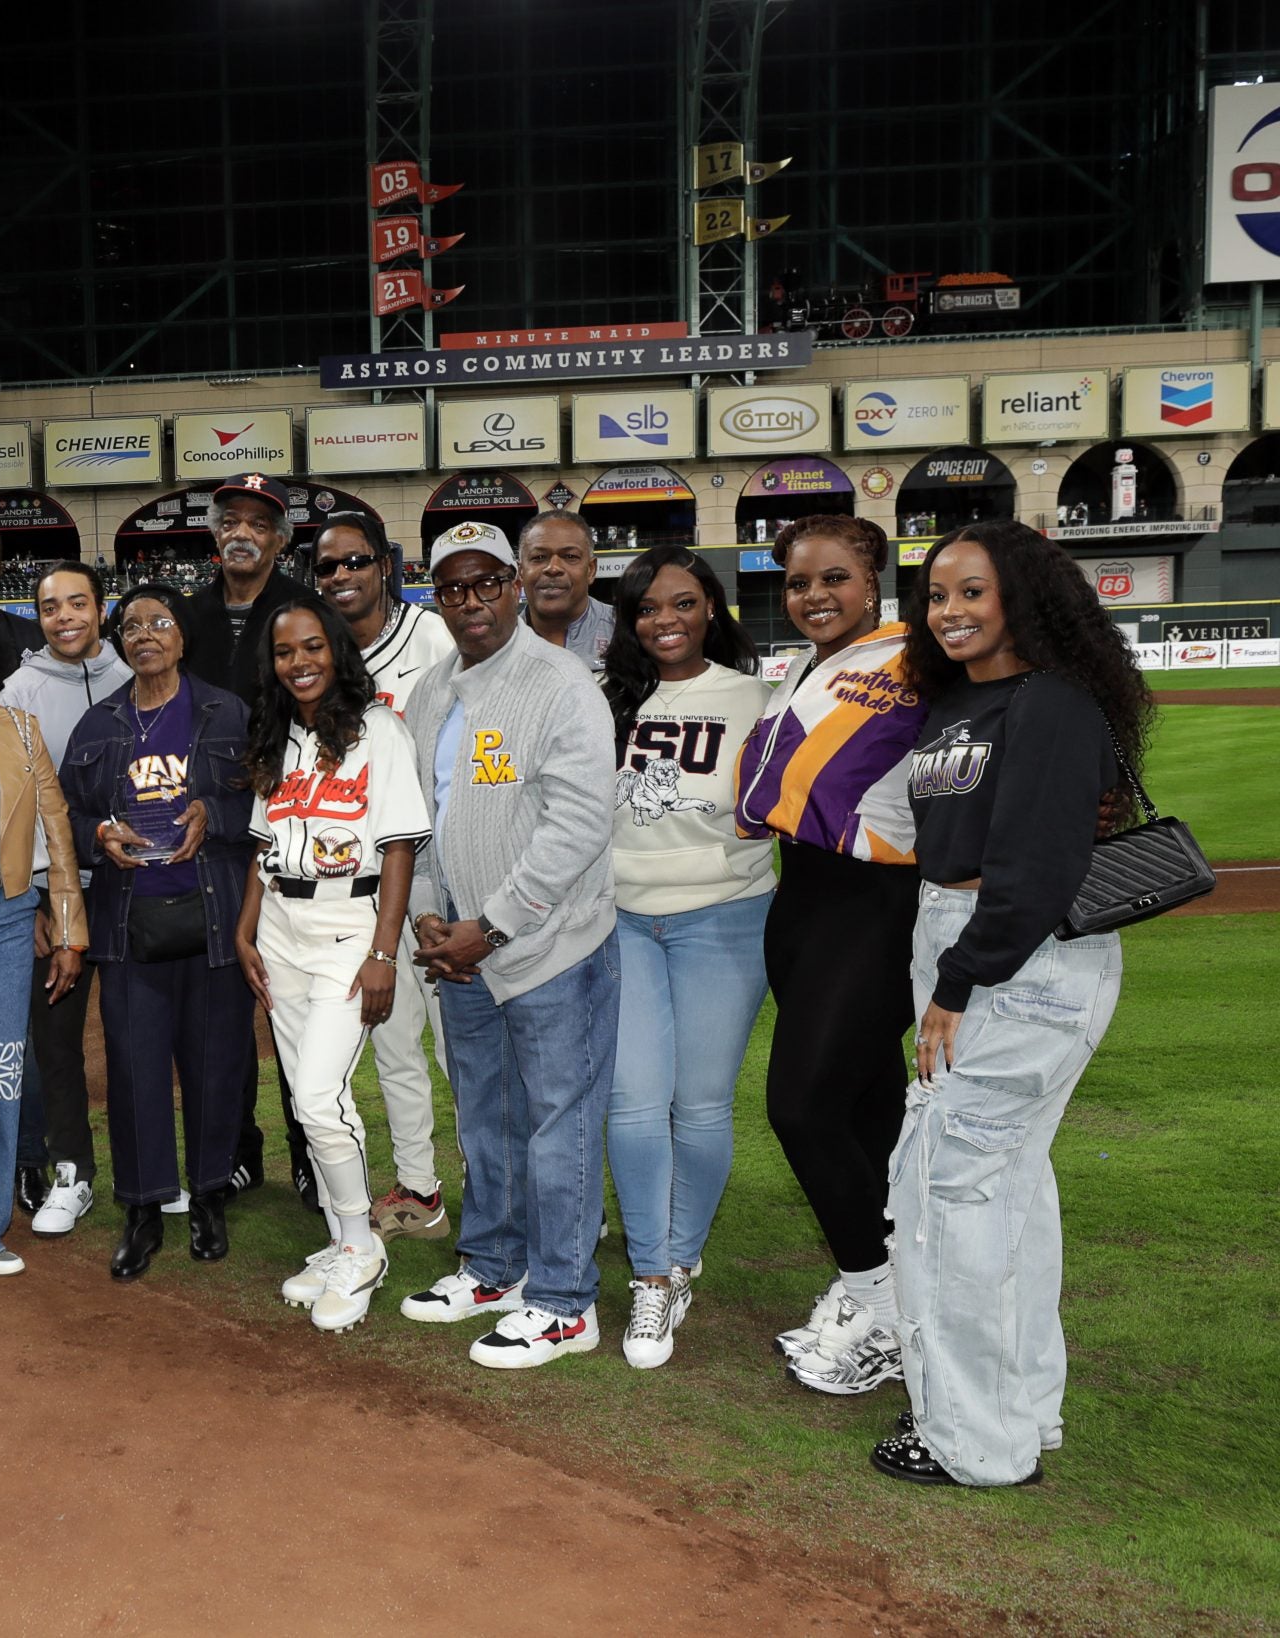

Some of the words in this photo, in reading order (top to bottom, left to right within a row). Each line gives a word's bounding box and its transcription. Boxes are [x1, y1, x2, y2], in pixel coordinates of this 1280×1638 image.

[706, 151, 732, 174] 17
[380, 169, 408, 193] 05
[378, 187, 418, 206] CHAMPIONS
[706, 210, 731, 231] 22
[384, 226, 410, 249] 19
[380, 242, 418, 260] CHAMPIONS
[383, 279, 409, 300] 21
[379, 296, 415, 312] CHAMPIONS
[477, 331, 569, 345] MINUTE
[589, 327, 650, 339] MAID
[340, 358, 447, 380] ASTROS
[462, 348, 646, 373] COMMUNITY
[660, 341, 790, 363] LEADERS
[1161, 371, 1214, 383] Chevron
[1000, 390, 1083, 415] reliant
[627, 403, 669, 430] slb
[732, 408, 803, 432] COTTON
[854, 407, 898, 420] OXY
[907, 406, 938, 419] ZERO
[1000, 424, 1012, 432] an
[1014, 422, 1036, 431] NRG
[1037, 421, 1081, 433] company
[55, 435, 151, 452] CHENIERE
[314, 432, 419, 446] HALLIBURTON
[453, 437, 545, 454] LEXUS
[183, 447, 284, 463] ConocoPhillips
[1200, 454, 1209, 462] 27
[927, 460, 965, 477] SPACE
[963, 459, 989, 475] CITY
[1033, 463, 1046, 471] DK
[244, 475, 264, 490] H
[597, 478, 648, 490] Crawford
[651, 477, 679, 488] Bock
[713, 476, 723, 484] 24
[782, 469, 825, 483] planet
[457, 487, 503, 495] LANDRY'S
[787, 479, 833, 491] fitness
[442, 497, 491, 507] CRAWFORD
[493, 496, 520, 505] BOXES
[32, 517, 58, 526] BOXES
[1062, 527, 1111, 537] PROVIDING
[1113, 525, 1148, 534] ENERGY.
[1149, 523, 1191, 533] IMPROVING
[1100, 566, 1129, 575] PHILLIPS
[1101, 577, 1127, 593] 66
[1140, 614, 1160, 623] 399
[1187, 625, 1263, 640] VERITEX
[827, 669, 917, 704] panthers
[835, 686, 891, 713] made
[910, 743, 991, 797] VAMU
